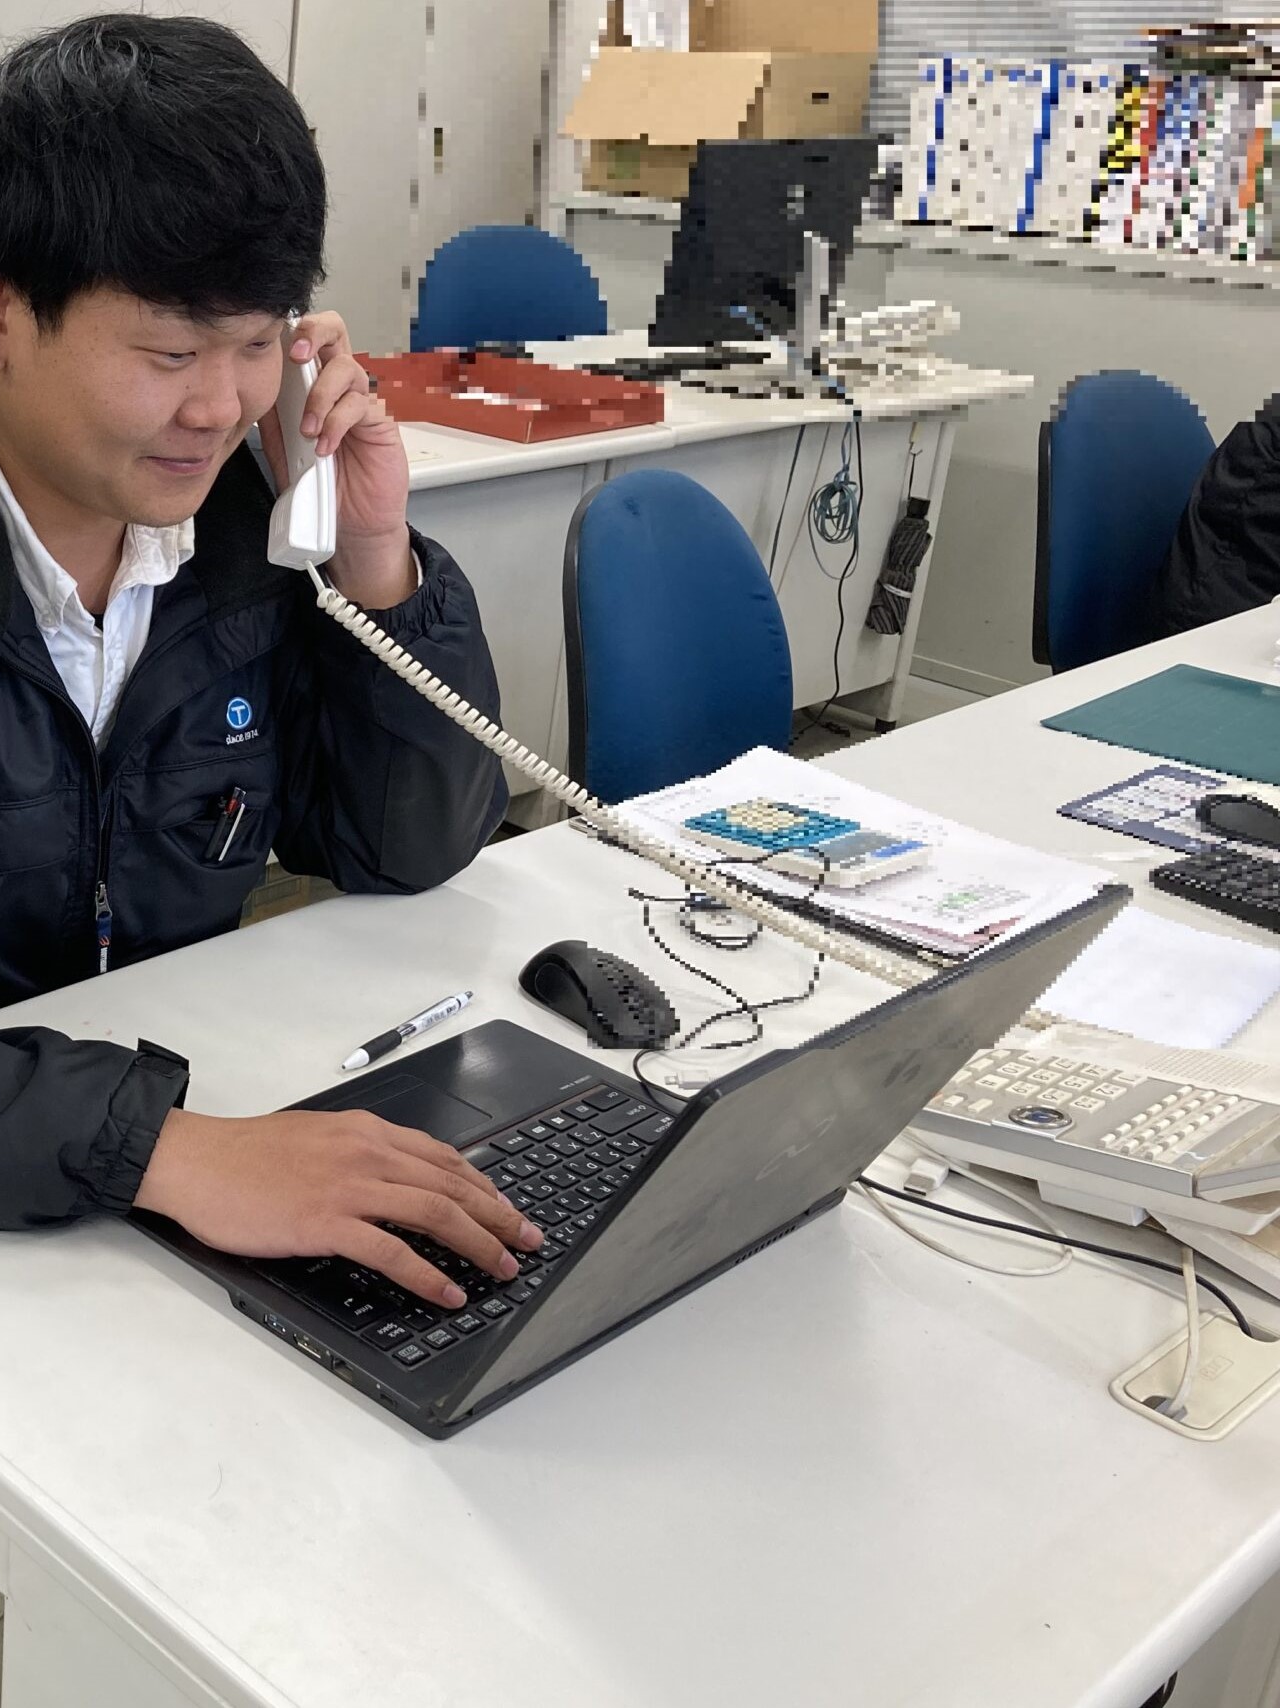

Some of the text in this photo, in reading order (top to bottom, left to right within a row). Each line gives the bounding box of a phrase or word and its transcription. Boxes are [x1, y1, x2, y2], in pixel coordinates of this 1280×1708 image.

[231, 704, 246, 725] T
[244, 728, 259, 740] 1974
[525, 1164, 536, 1172] V
[354, 1304, 373, 1316] Enter
[377, 1323, 398, 1335] Space
[388, 1328, 406, 1338] Back
